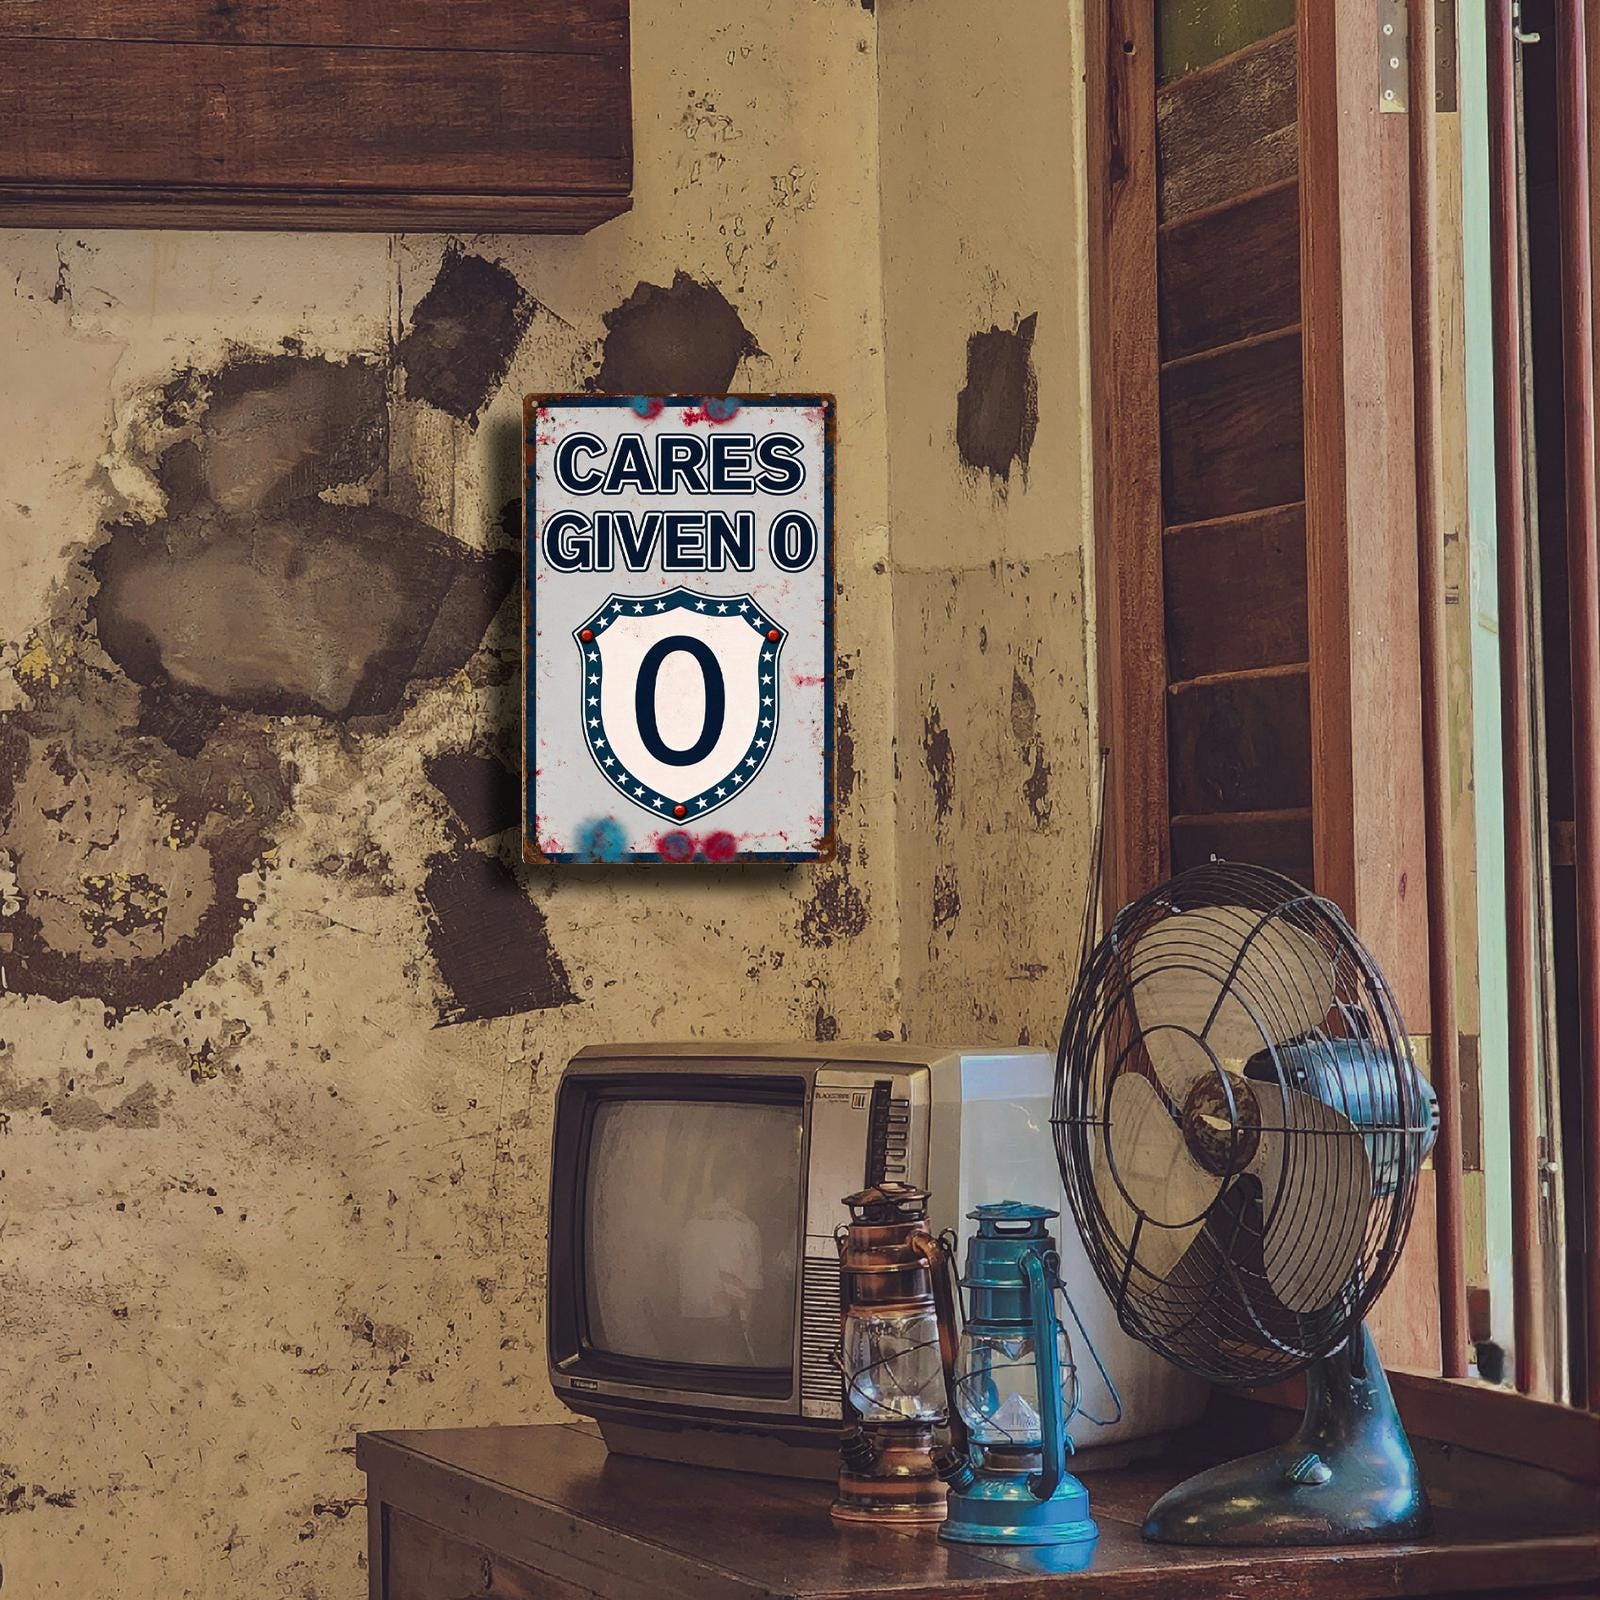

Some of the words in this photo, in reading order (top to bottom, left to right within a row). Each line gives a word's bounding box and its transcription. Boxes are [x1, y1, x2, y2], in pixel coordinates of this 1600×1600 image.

[554, 433, 806, 496] CARES
[542, 510, 756, 573] GIVEN
[769, 510, 818, 573] 0
[635, 635, 726, 767] 0
